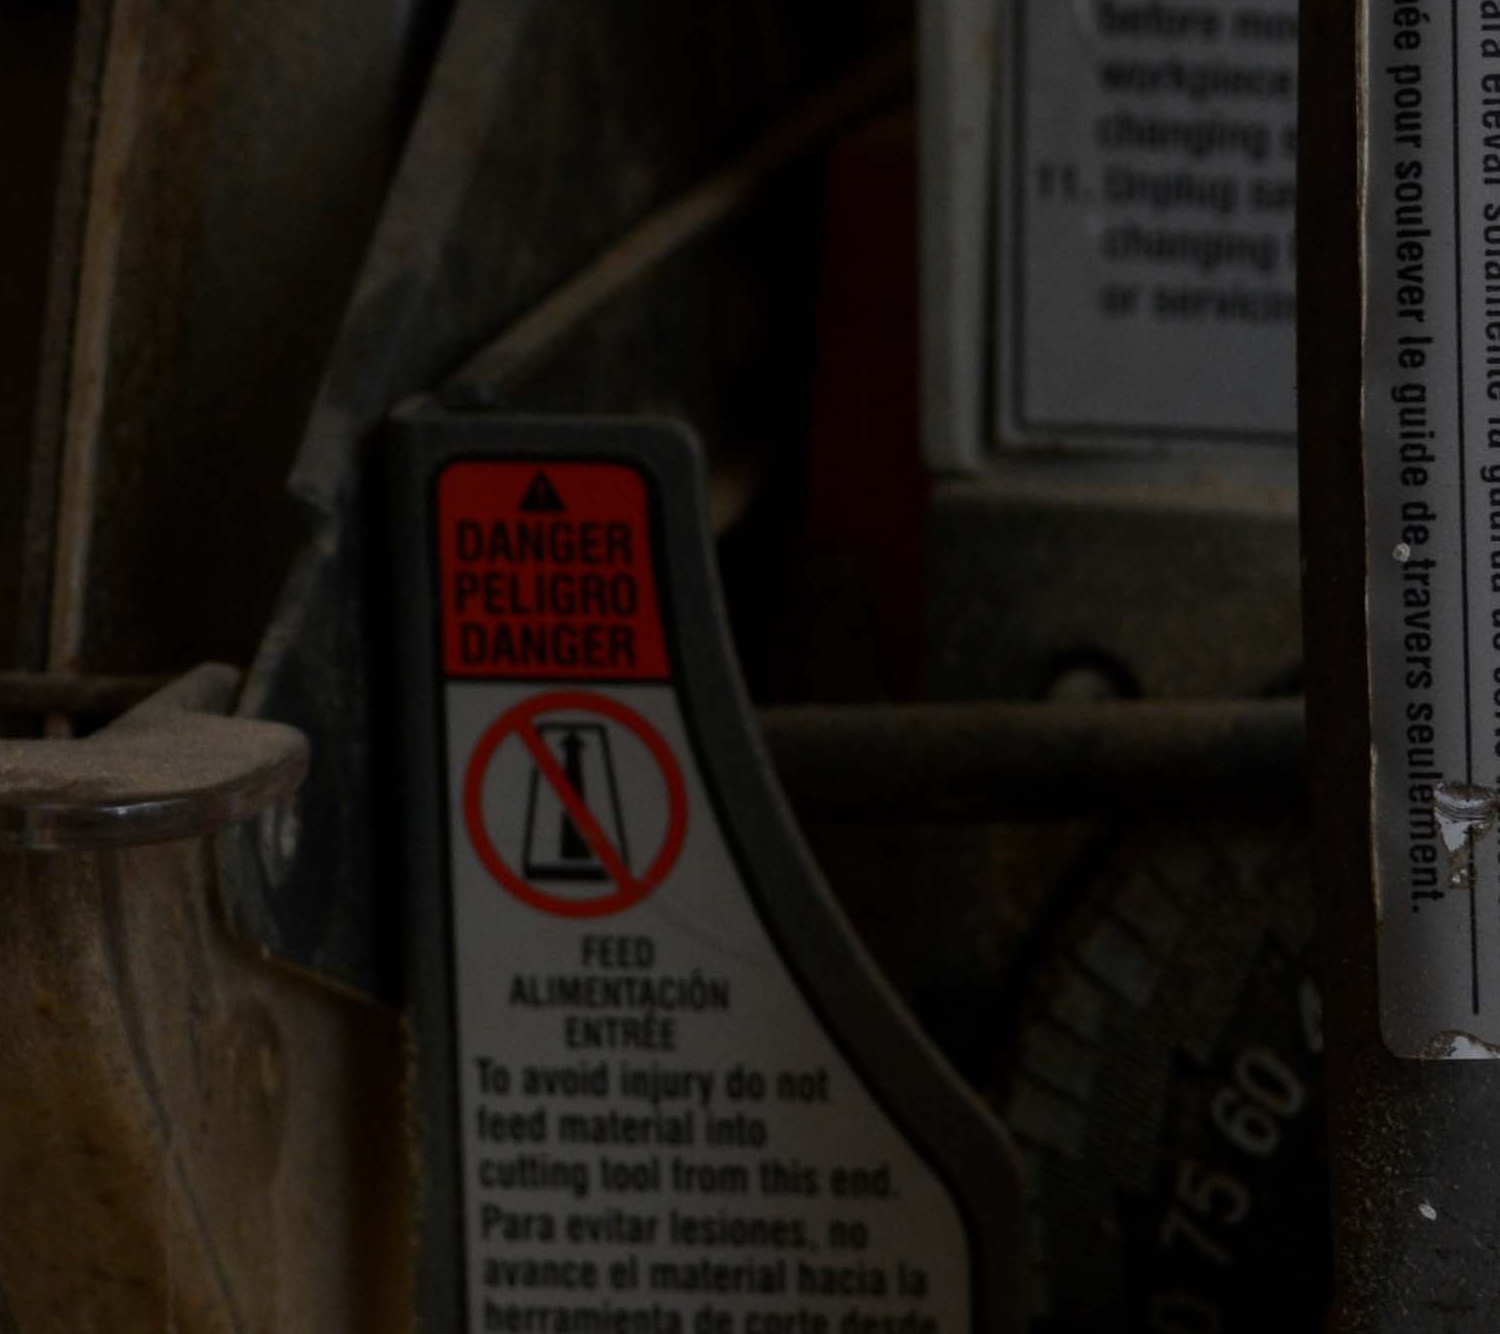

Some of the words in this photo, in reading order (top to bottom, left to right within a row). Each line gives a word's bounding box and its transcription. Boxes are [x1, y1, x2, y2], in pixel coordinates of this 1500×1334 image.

[1386, 63, 1423, 148] pour
[1394, 160, 1432, 323] soulever
[1398, 336, 1434, 370] le
[1390, 381, 1436, 488] guide
[454, 519, 634, 566] DANGER
[1401, 499, 1437, 549] de
[452, 570, 638, 615] PELIGRO
[458, 621, 637, 668] DANGER
[1402, 559, 1437, 690] travers
[1404, 701, 1446, 915] seulement.
[581, 934, 655, 969] FEED
[509, 969, 730, 1011] ALIMENTACIÓN
[564, 1011, 678, 1052] ENTRÉE
[476, 1060, 510, 1097] To
[523, 1061, 608, 1099] avoid
[622, 1064, 713, 1107] injury
[726, 1065, 764, 1101] do
[776, 1067, 829, 1103] not
[1211, 1049, 1303, 1158] 60
[477, 1106, 546, 1143] feed
[559, 1108, 694, 1146] material
[705, 1112, 767, 1148] into
[480, 1156, 589, 1197] cutting
[602, 1158, 661, 1192] tool
[673, 1161, 749, 1194] from
[760, 1162, 819, 1197] this
[831, 1164, 897, 1198] end.
[481, 1204, 553, 1241] Para
[567, 1208, 657, 1245] evitar
[670, 1210, 819, 1252] lesiones,
[829, 1219, 867, 1250] no
[1156, 1159, 1252, 1267] 75
[484, 1258, 597, 1288] avance
[610, 1255, 638, 1288] el
[651, 1257, 786, 1294] material
[798, 1261, 886, 1296] hacia
[898, 1264, 927, 1297] la
